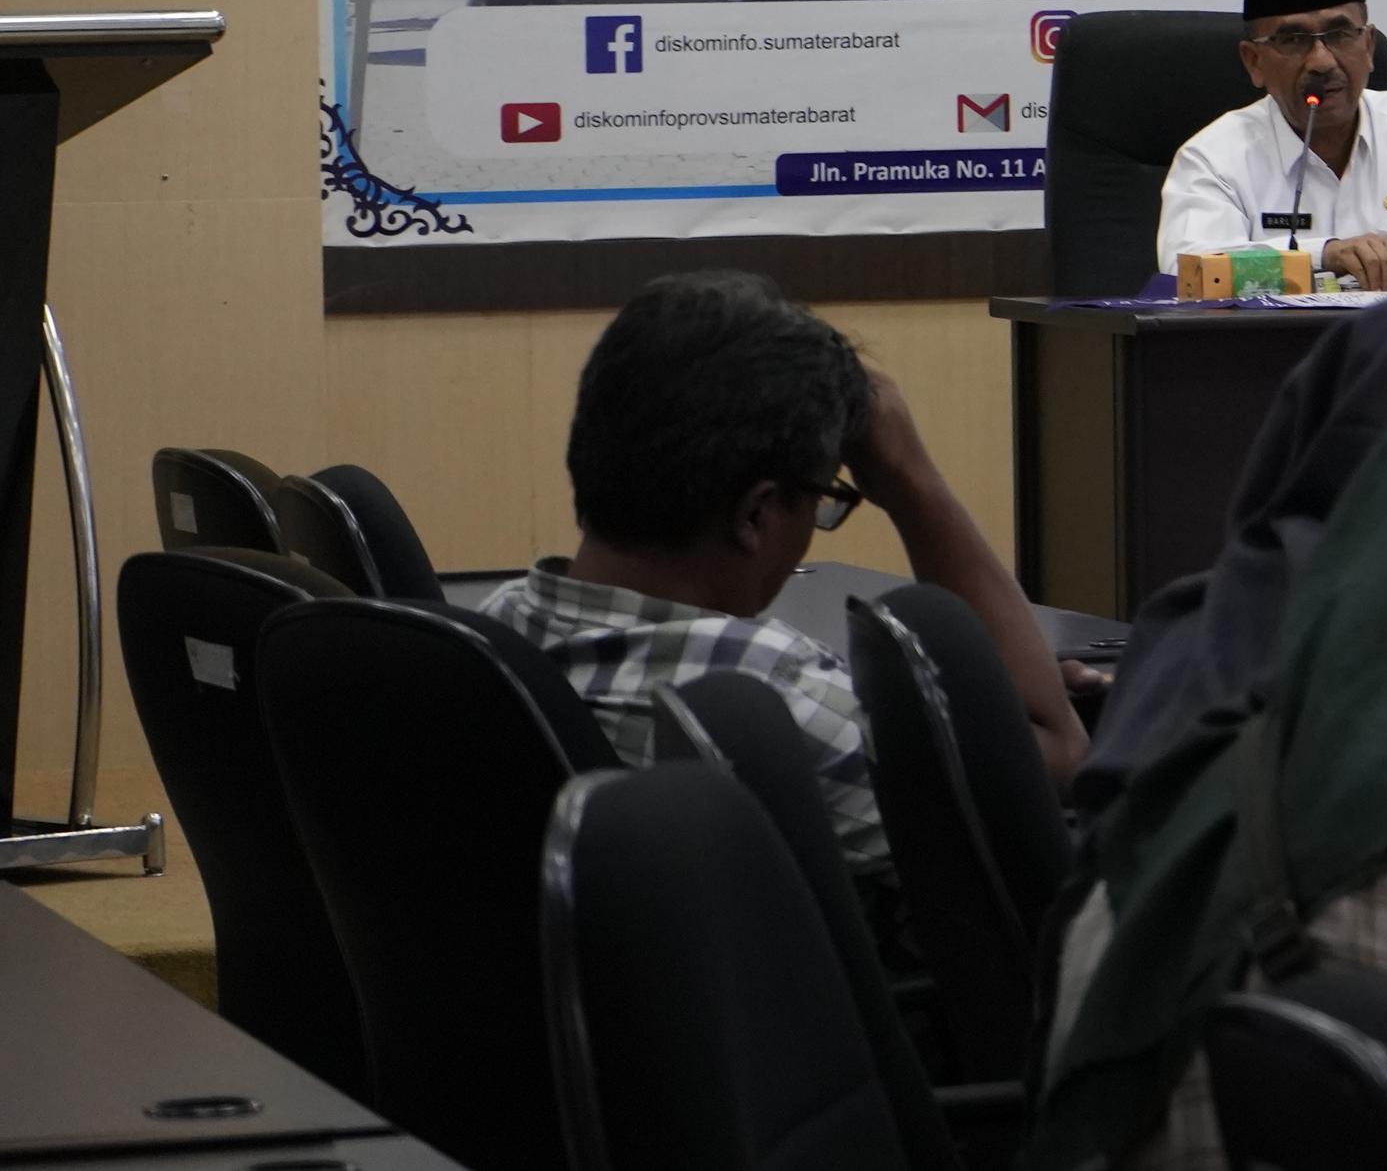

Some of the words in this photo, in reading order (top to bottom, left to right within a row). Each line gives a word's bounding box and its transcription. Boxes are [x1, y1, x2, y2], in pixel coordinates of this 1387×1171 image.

[655, 30, 901, 53] diskominfo.sumaterabarat
[575, 105, 856, 130] diskominfoprovsumaterabarat
[1021, 101, 1048, 119] dis
[810, 162, 848, 183] Jln.
[854, 159, 950, 181] Pramuka
[957, 159, 994, 178] No.
[1001, 158, 1025, 178] 11
